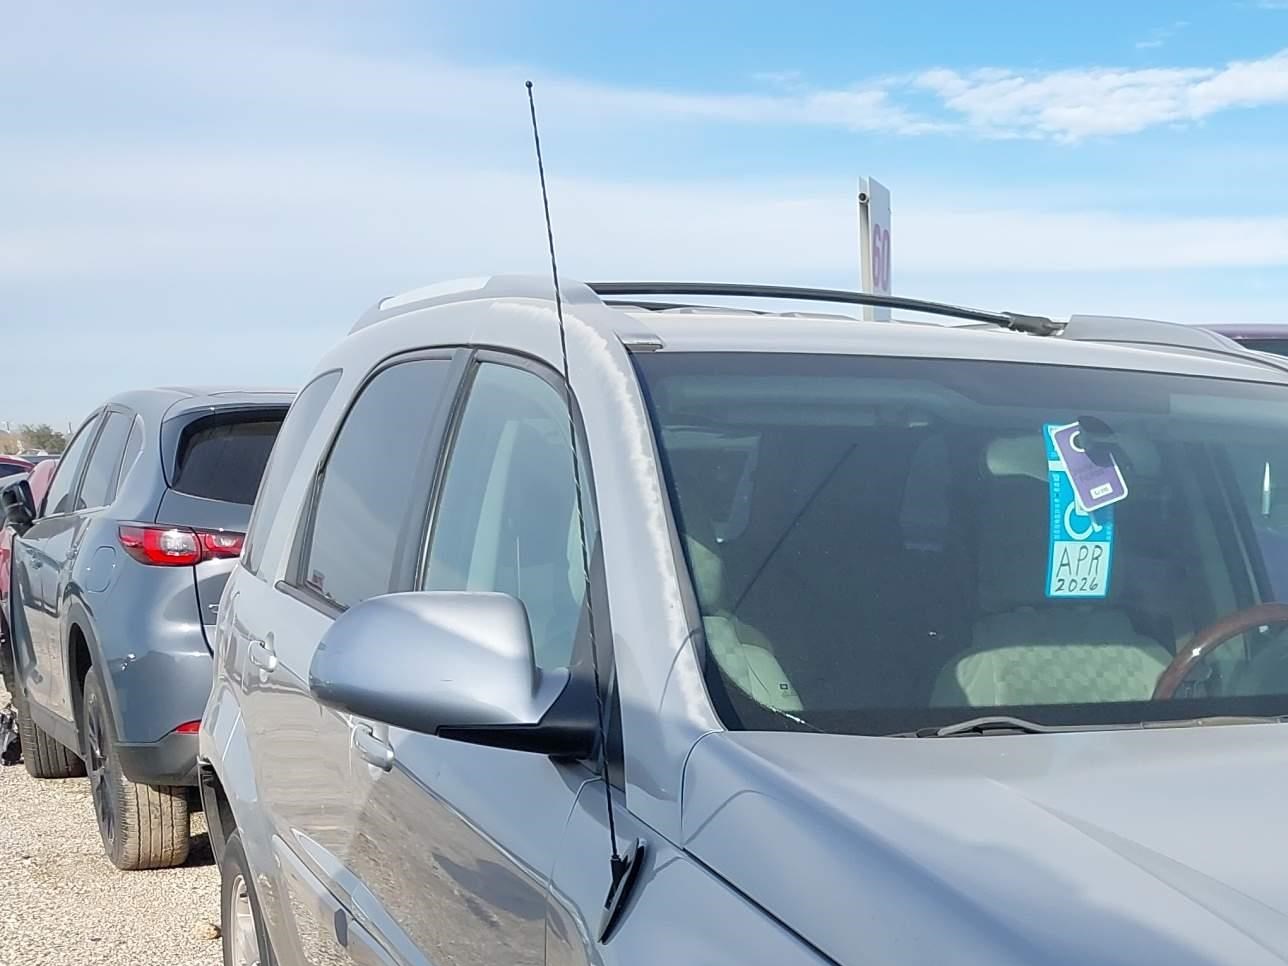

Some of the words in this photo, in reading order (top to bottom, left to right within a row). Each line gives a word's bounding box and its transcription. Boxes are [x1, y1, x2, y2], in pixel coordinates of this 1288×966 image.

[872, 223, 891, 291] 60
[1056, 544, 1104, 578] APR
[1055, 577, 1099, 593] 2026
